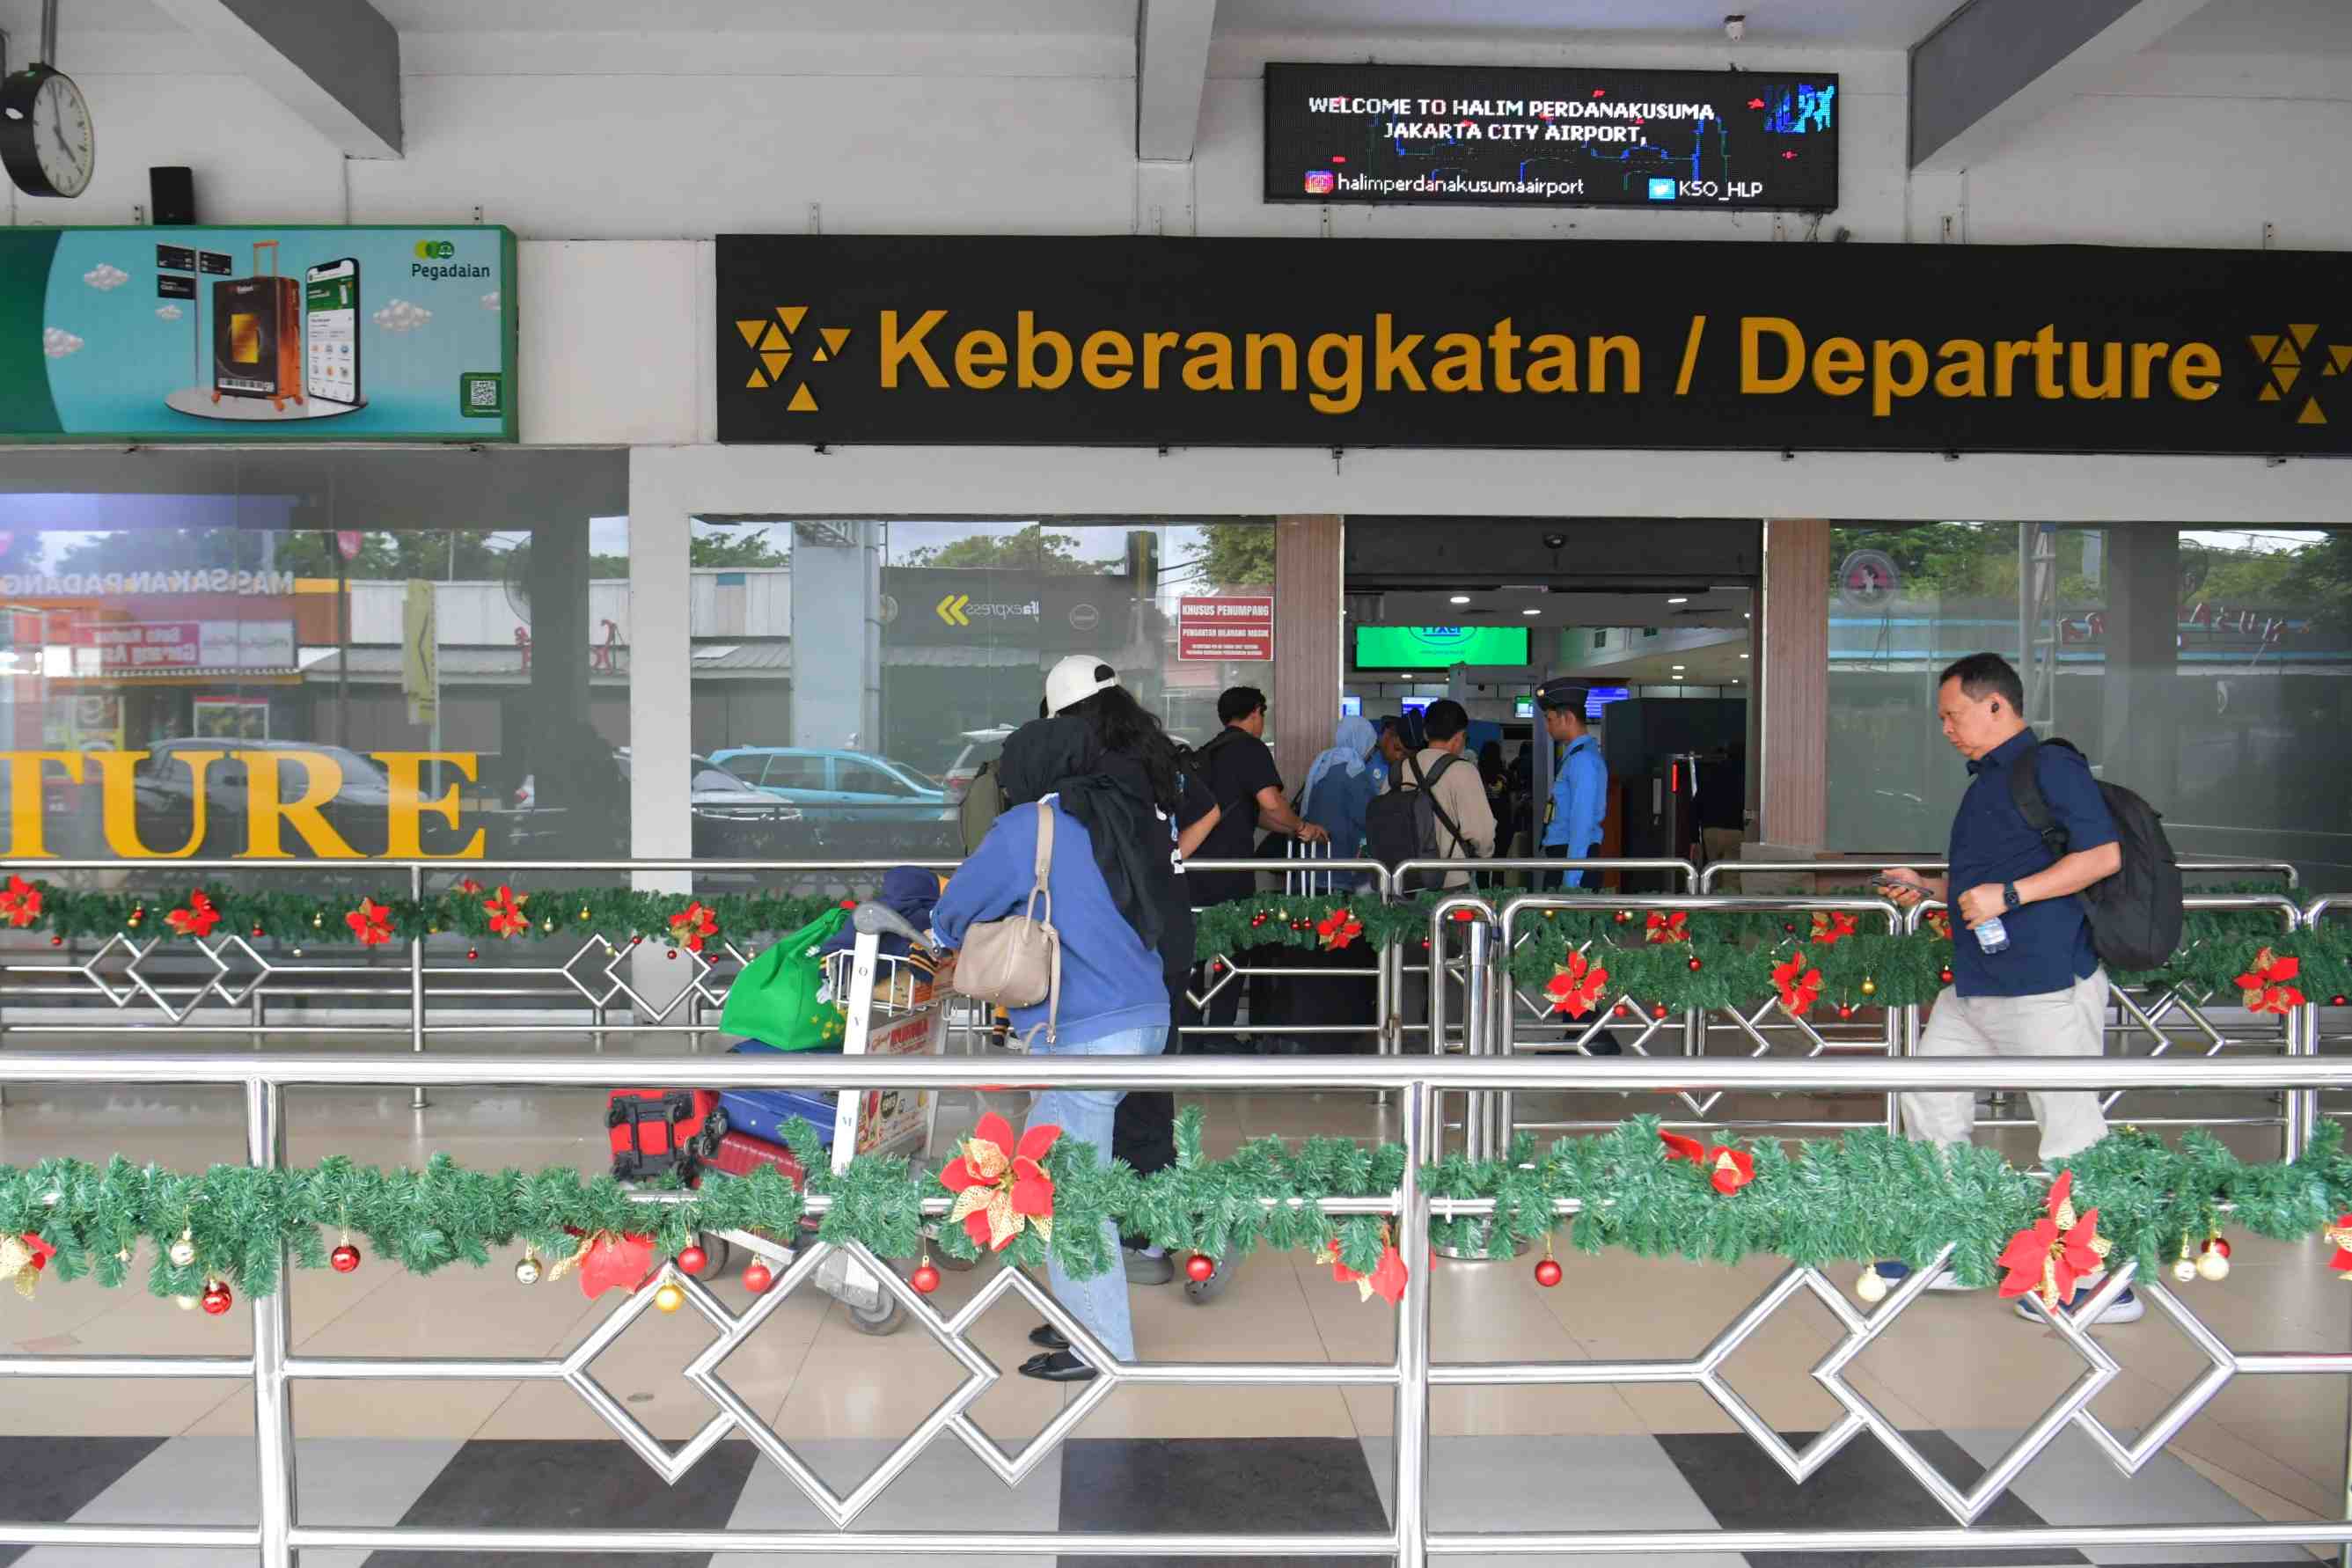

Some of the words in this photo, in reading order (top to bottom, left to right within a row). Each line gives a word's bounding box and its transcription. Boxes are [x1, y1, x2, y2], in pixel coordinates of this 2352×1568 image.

[1308, 97, 1412, 115] WELCOME
[1417, 99, 1447, 115] TO
[1453, 99, 1524, 117] HALIM
[1528, 101, 1716, 120] PERDANAKUSUMA
[1383, 122, 1483, 140] JAKARTA
[1487, 123, 1539, 141] CITY
[1544, 124, 1647, 146] AIRPORT,
[1338, 172, 1585, 197] halimperdanakusumaairport
[1679, 180, 1763, 201] KSO_HLP
[411, 263, 490, 281] Pegadaian
[881, 310, 1640, 414] Keberangkatan
[1674, 314, 1706, 396] /
[1740, 317, 2222, 416] Departure
[1182, 604, 1215, 616] KHUSUS
[1217, 605, 1270, 617] PENUMPANG
[0, 750, 486, 859] TURE
